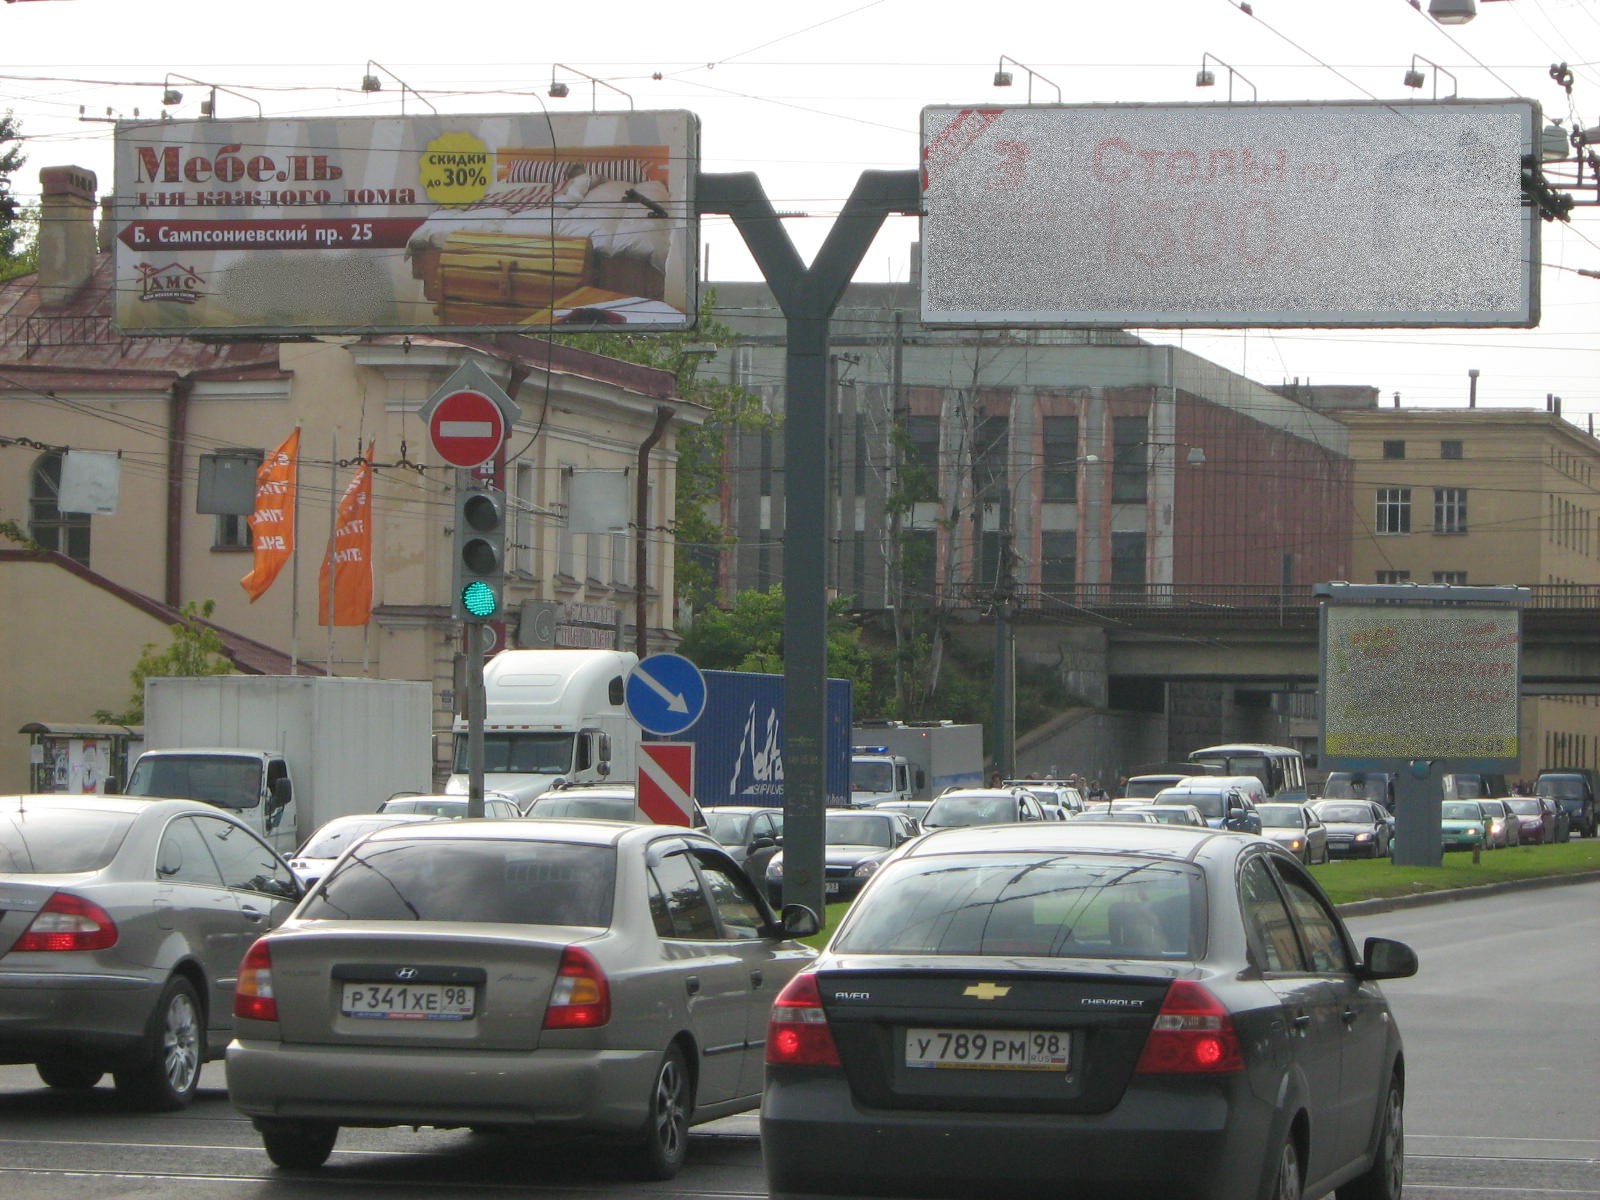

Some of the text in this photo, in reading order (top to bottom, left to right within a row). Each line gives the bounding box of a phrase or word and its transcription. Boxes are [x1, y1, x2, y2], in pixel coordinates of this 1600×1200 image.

[134, 143, 343, 184] Мебель
[443, 167, 487, 187] 30%
[196, 189, 332, 208] каждого
[343, 187, 416, 207] дома
[134, 224, 373, 245] Б. Сампсониевский пр. 25
[445, 988, 466, 1005] 98
[835, 991, 870, 999] AVEO
[1081, 998, 1145, 1006] CHEVROLET
[1033, 1034, 1060, 1054] 98
[1031, 1054, 1050, 1063] RUS
